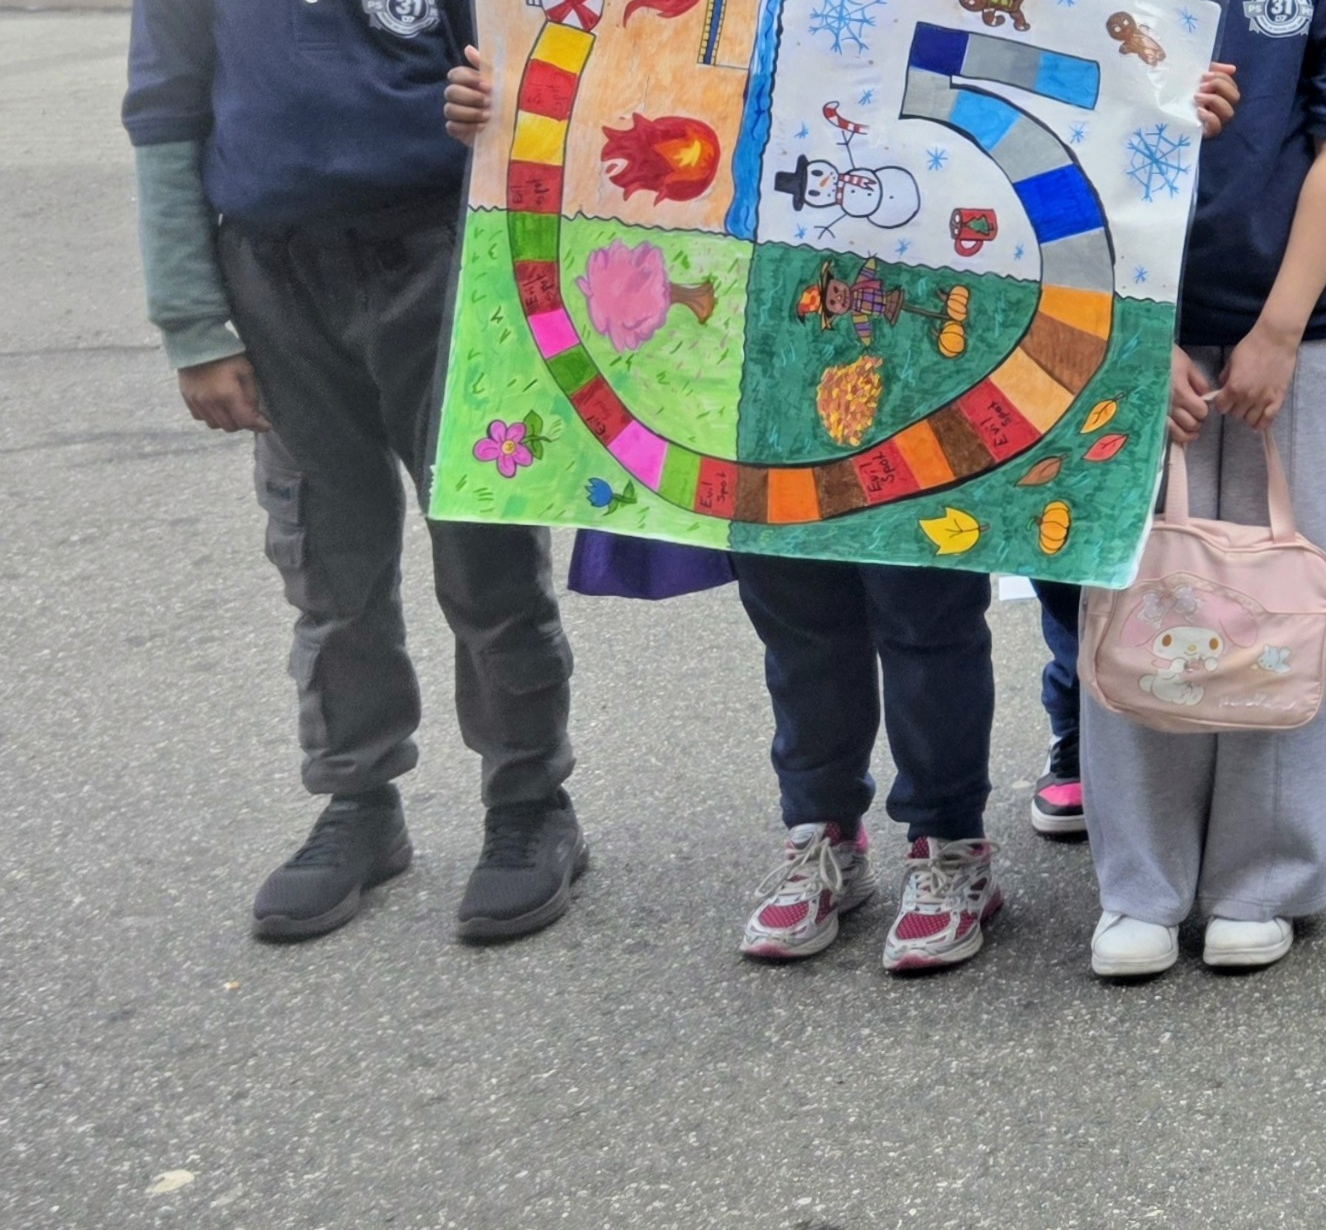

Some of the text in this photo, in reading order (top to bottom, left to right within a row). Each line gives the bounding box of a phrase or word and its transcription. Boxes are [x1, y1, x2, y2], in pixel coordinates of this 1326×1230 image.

[367, 0, 383, 10] PS
[1248, 4, 1262, 13] PS
[980, 416, 1009, 448] Evil
[858, 461, 882, 494] Evil
[699, 481, 714, 510] Evil
